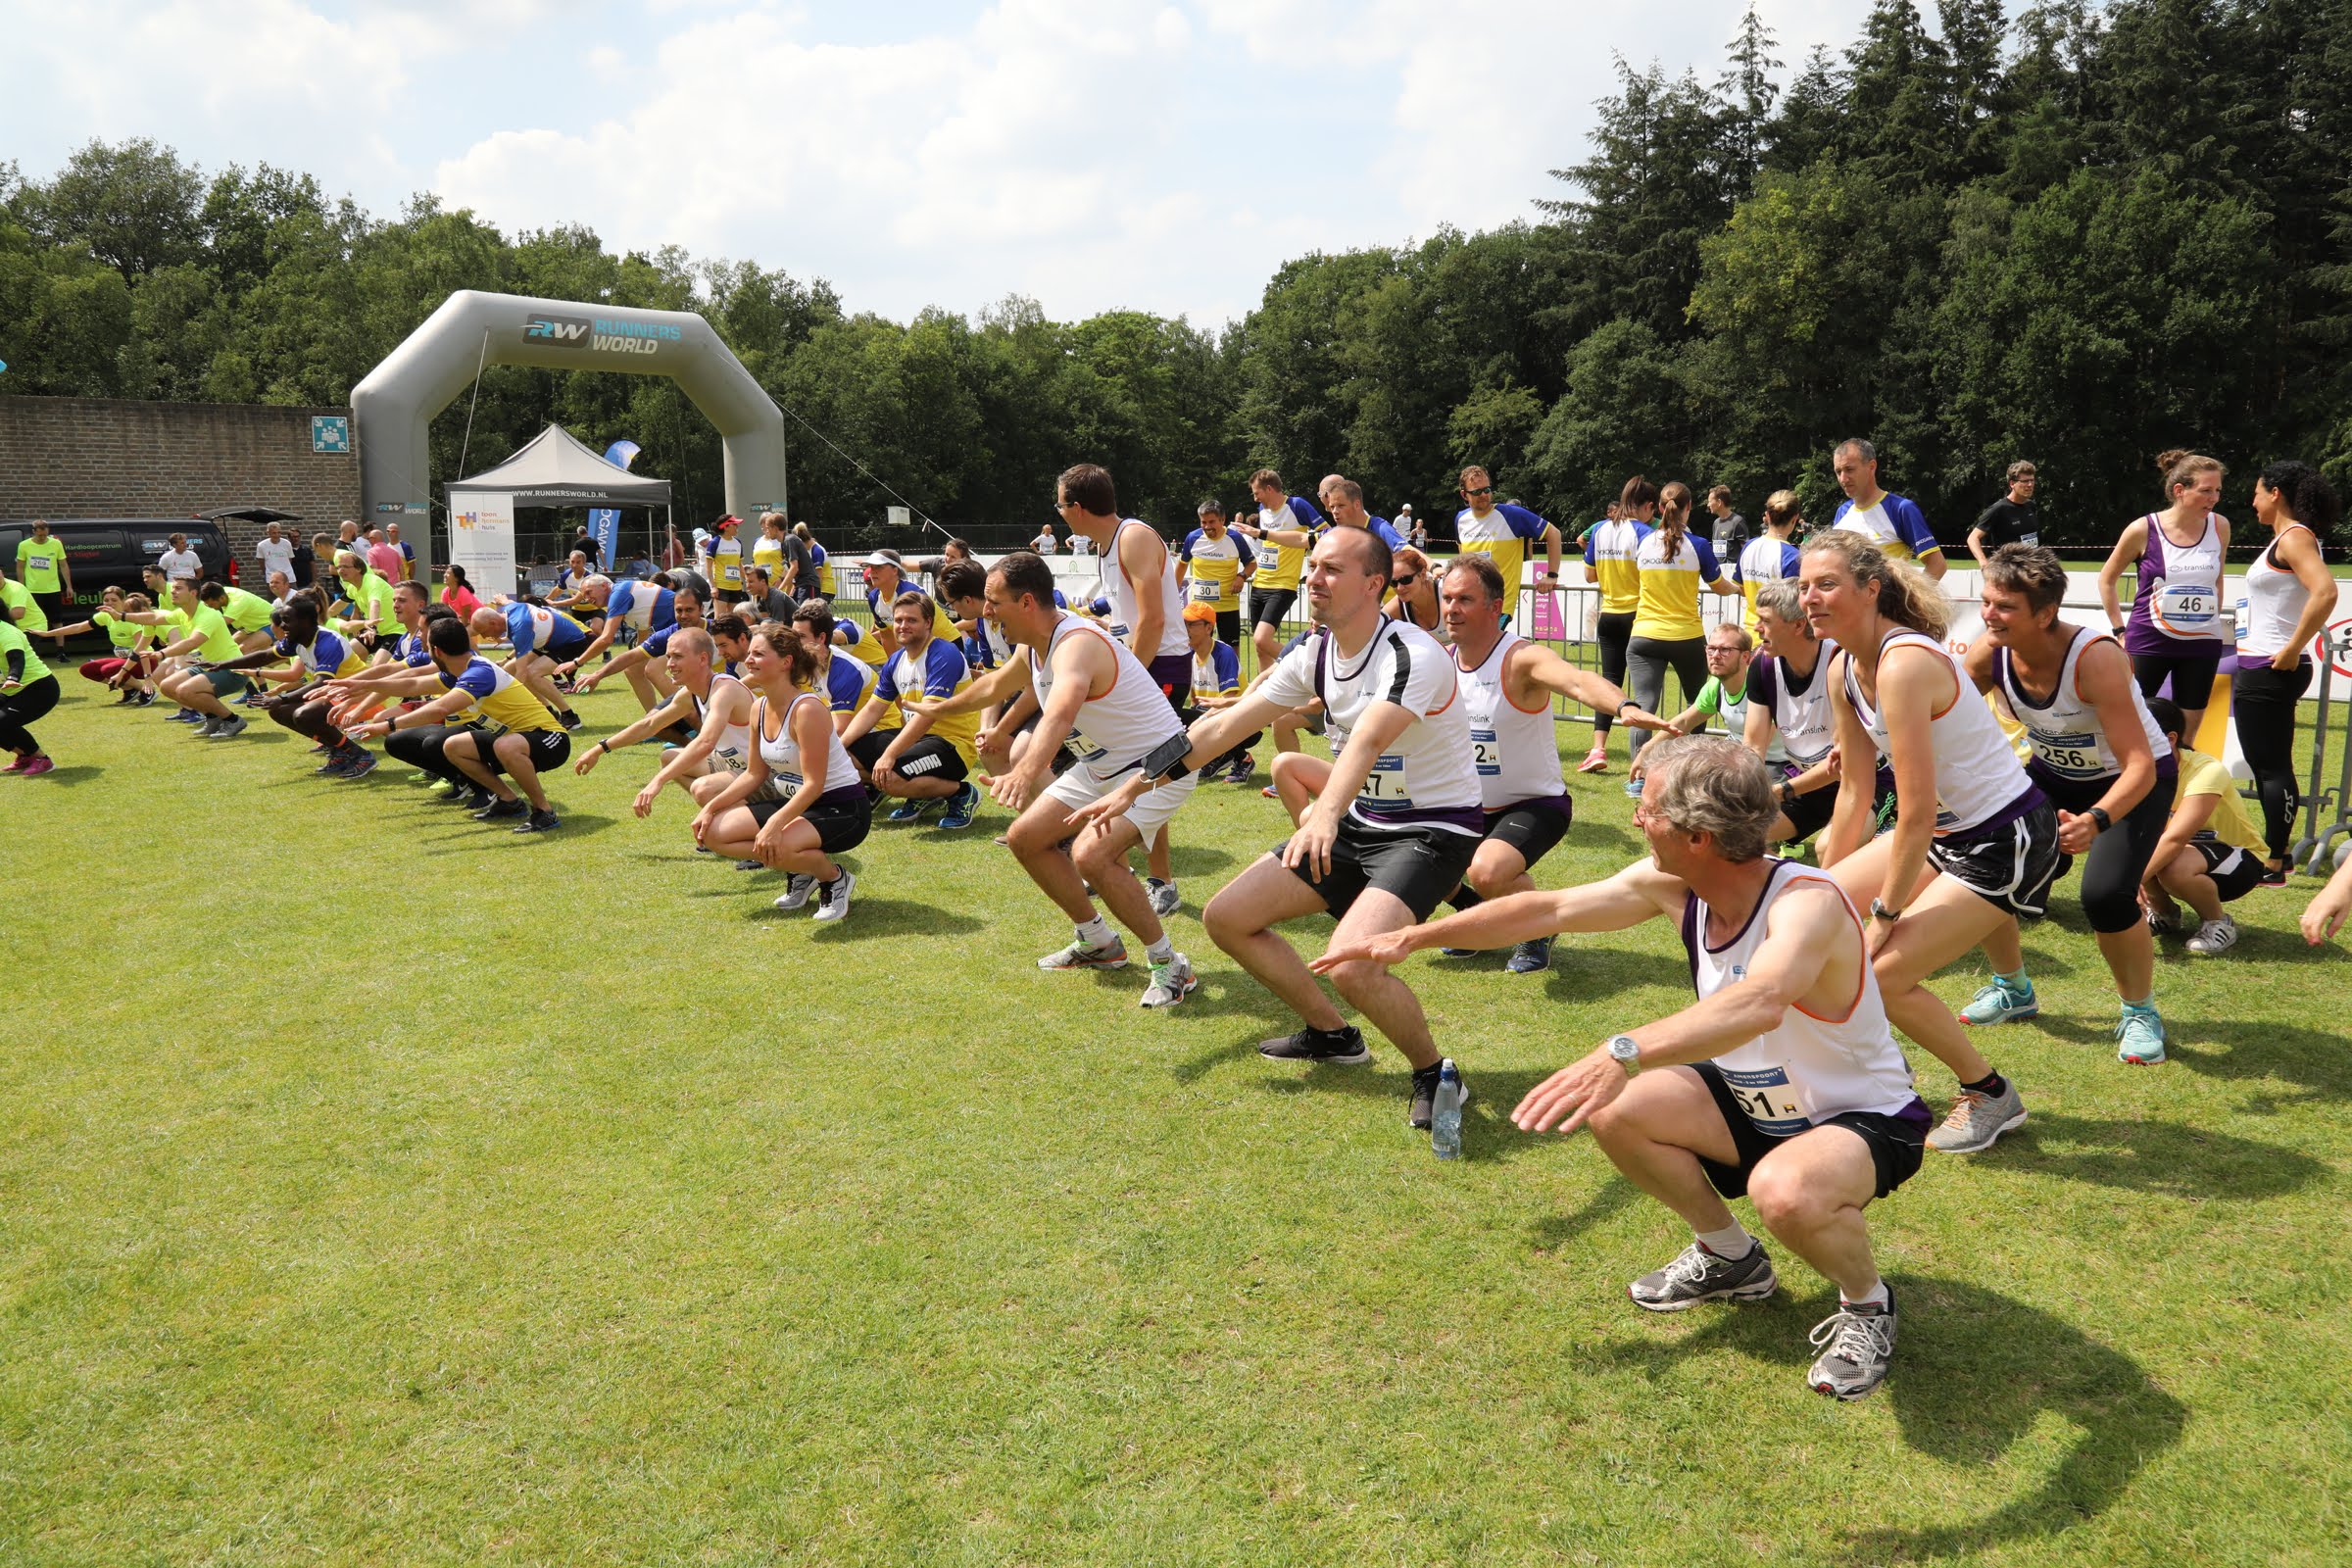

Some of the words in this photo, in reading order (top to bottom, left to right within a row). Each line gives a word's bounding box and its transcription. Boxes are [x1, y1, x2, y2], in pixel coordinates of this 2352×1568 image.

[596, 319, 682, 340] RUNNERS
[592, 334, 659, 355] WORLD
[513, 490, 609, 499] WWW.RUNNERSWORLD.NL
[1200, 586, 1211, 596] 30
[2179, 597, 2202, 612] 46
[1468, 714, 1491, 723] nslink
[902, 754, 942, 775] PUMA
[2039, 745, 2085, 767] 256
[1732, 1087, 1776, 1117] 51
